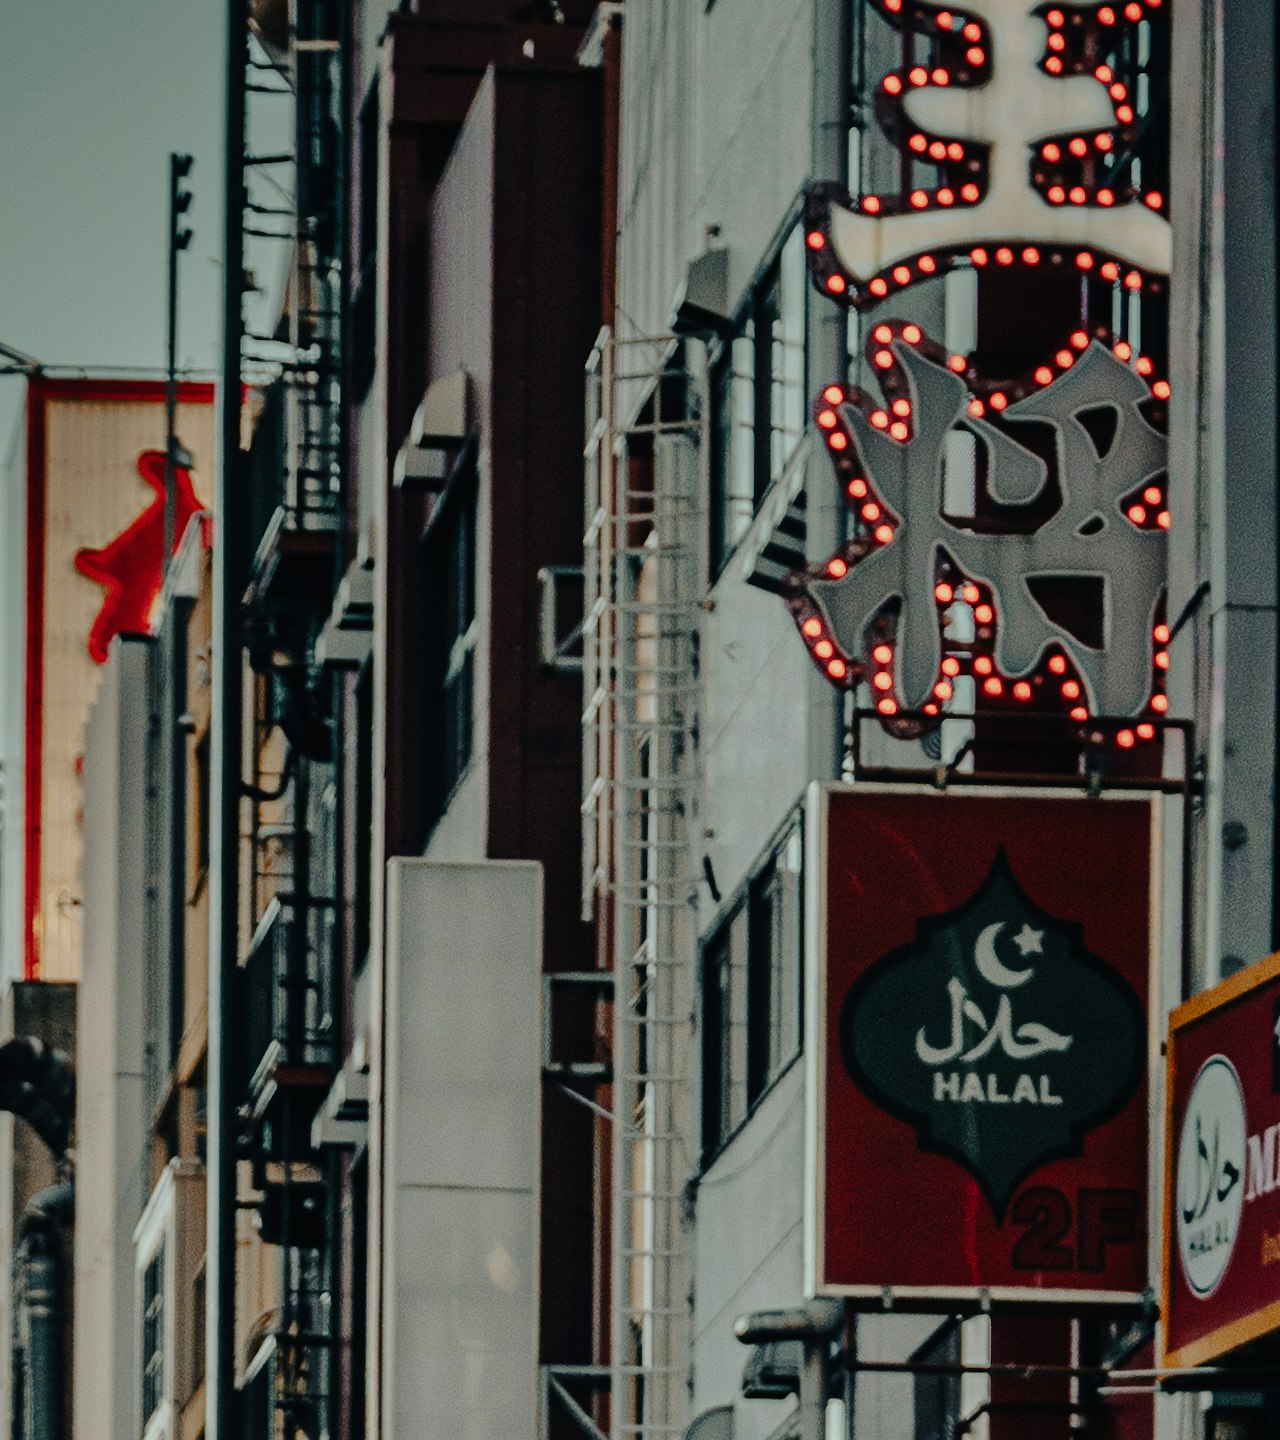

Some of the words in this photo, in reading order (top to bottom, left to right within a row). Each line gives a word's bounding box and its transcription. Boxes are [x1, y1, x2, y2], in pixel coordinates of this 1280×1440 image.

[915, 975, 1074, 1066] حلال
[932, 1071, 1064, 1106] HALAL
[1012, 1185, 1139, 1272] 2F
